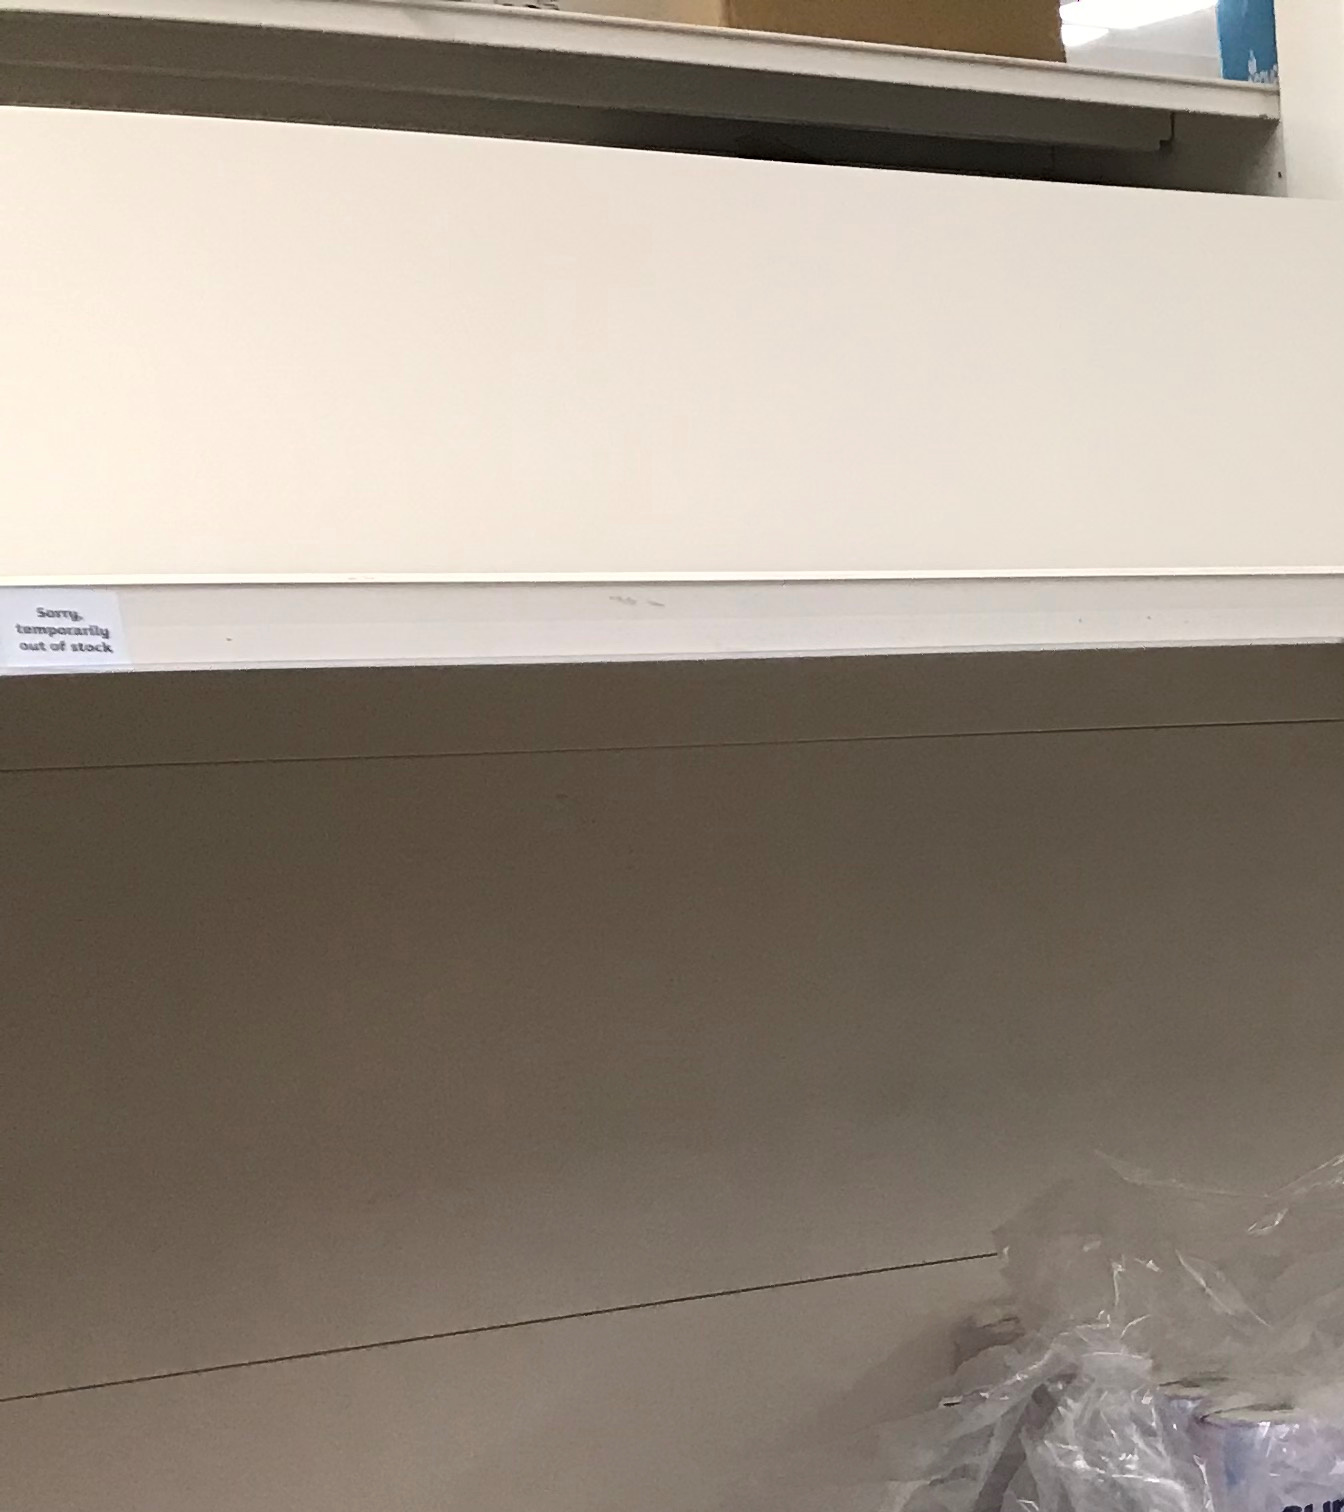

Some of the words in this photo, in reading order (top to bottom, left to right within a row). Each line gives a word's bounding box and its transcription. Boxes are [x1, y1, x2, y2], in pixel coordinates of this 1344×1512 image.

[36, 607, 84, 622] Sorry,
[15, 623, 110, 639] temporarily
[19, 641, 46, 652] out
[49, 640, 66, 652] of
[70, 641, 114, 653] stock
